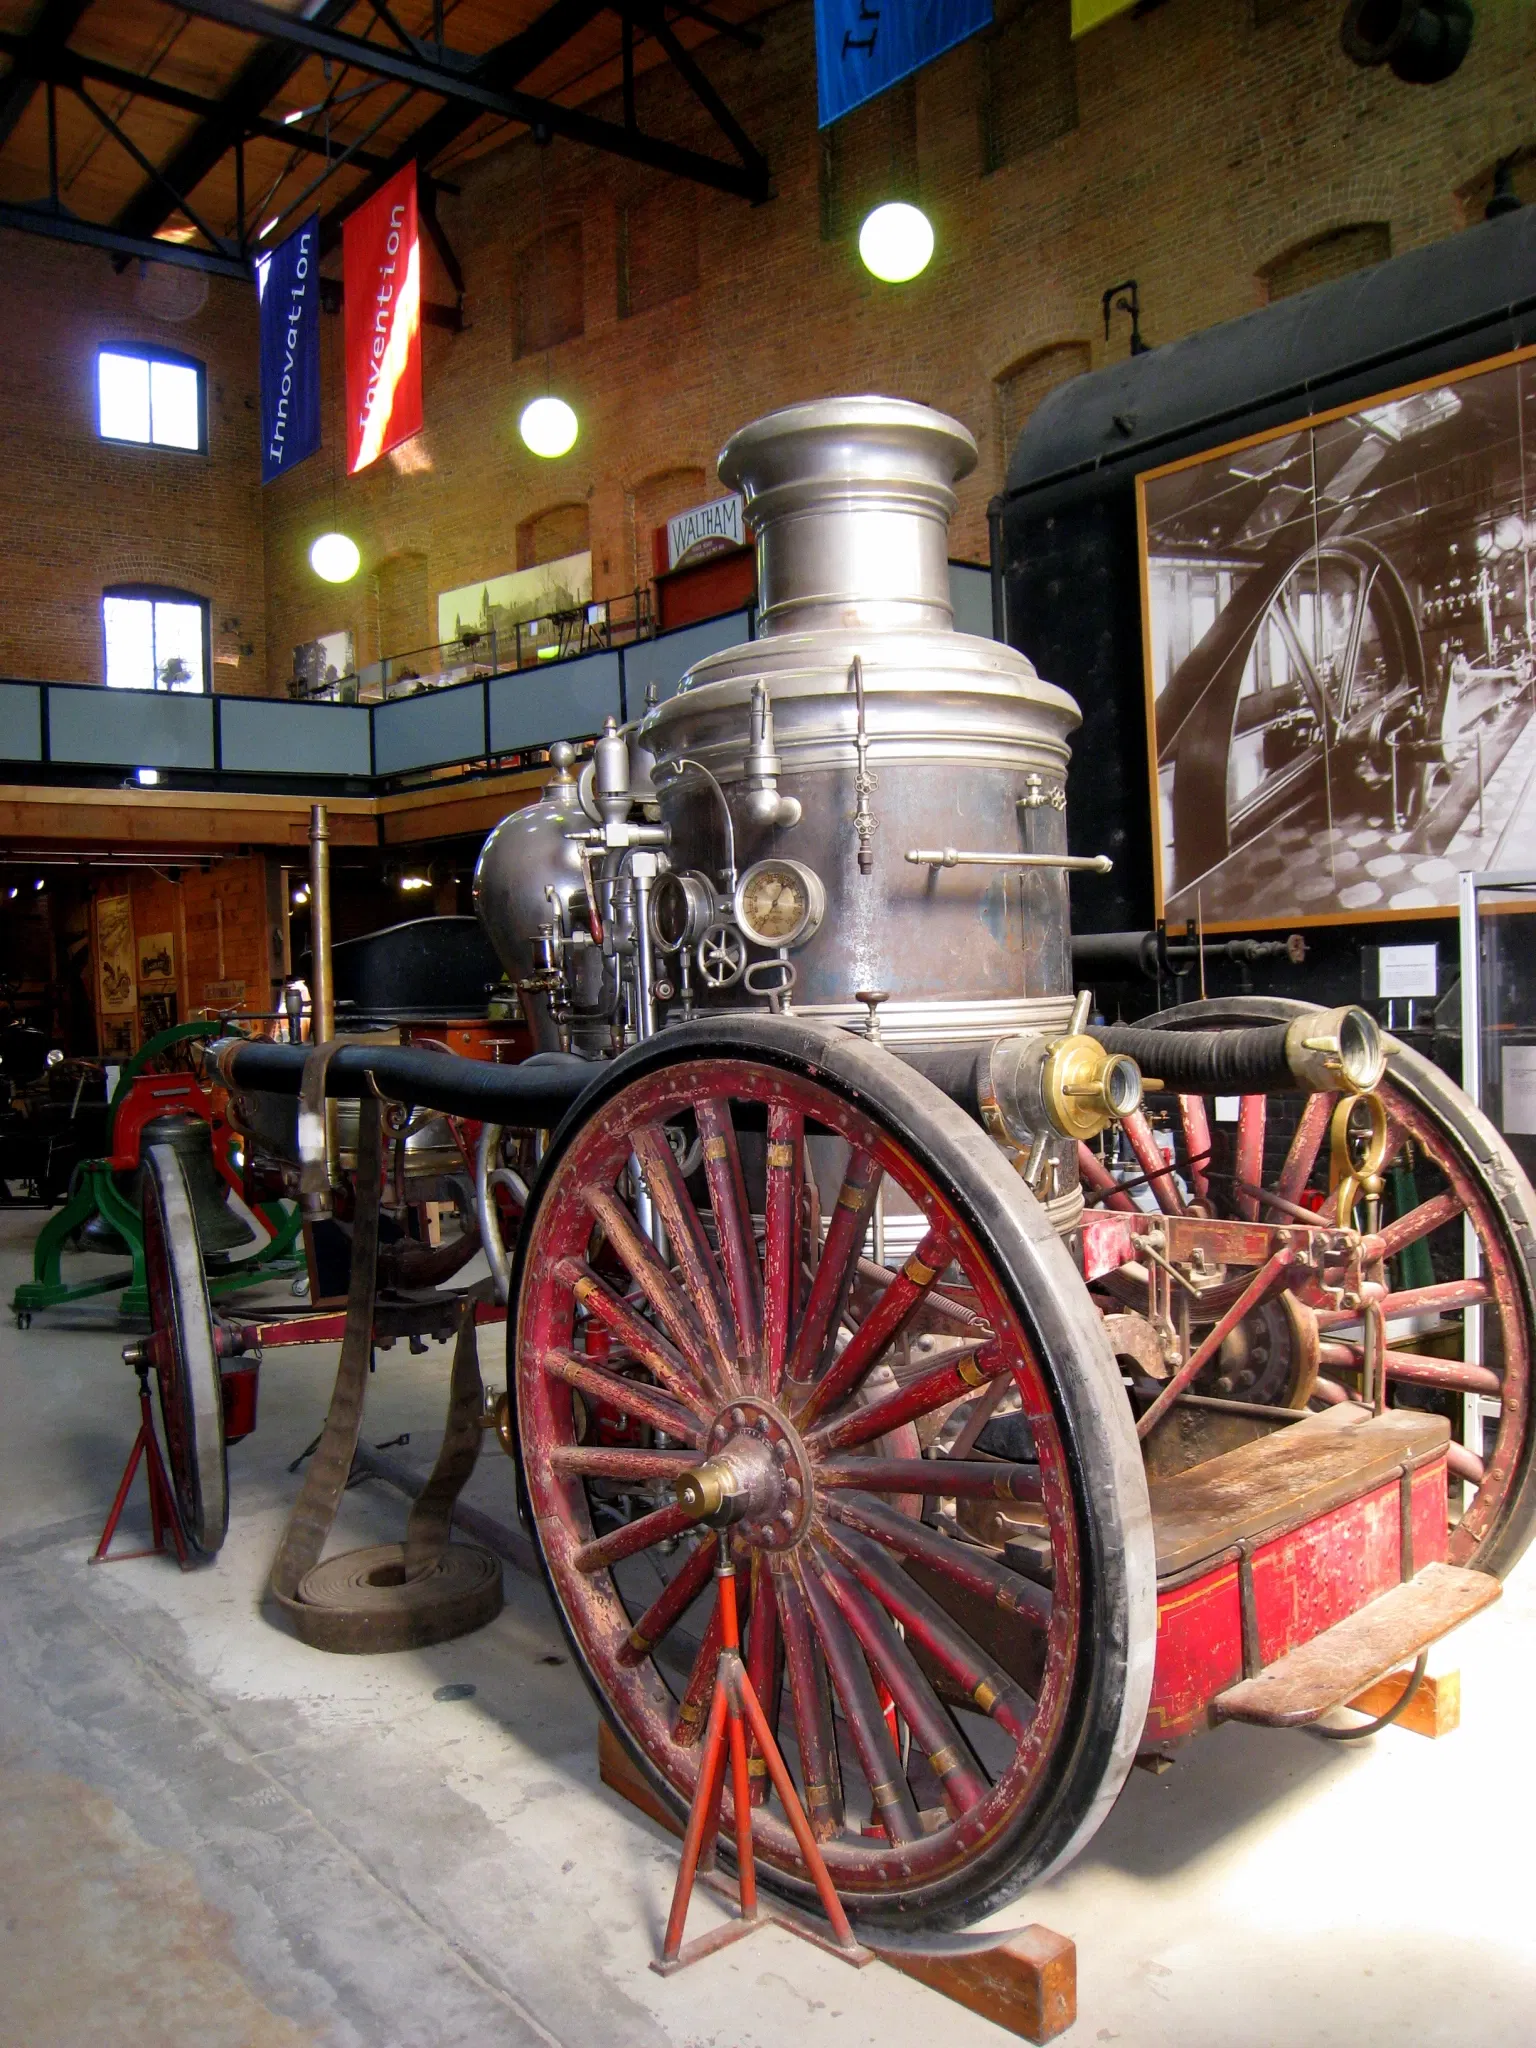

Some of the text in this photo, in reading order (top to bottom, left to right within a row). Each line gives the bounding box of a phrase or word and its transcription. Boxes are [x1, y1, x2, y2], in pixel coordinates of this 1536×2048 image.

[269, 233, 311, 465] Innovation
[358, 204, 405, 433] Invention
[672, 500, 737, 557] WALTHAM
